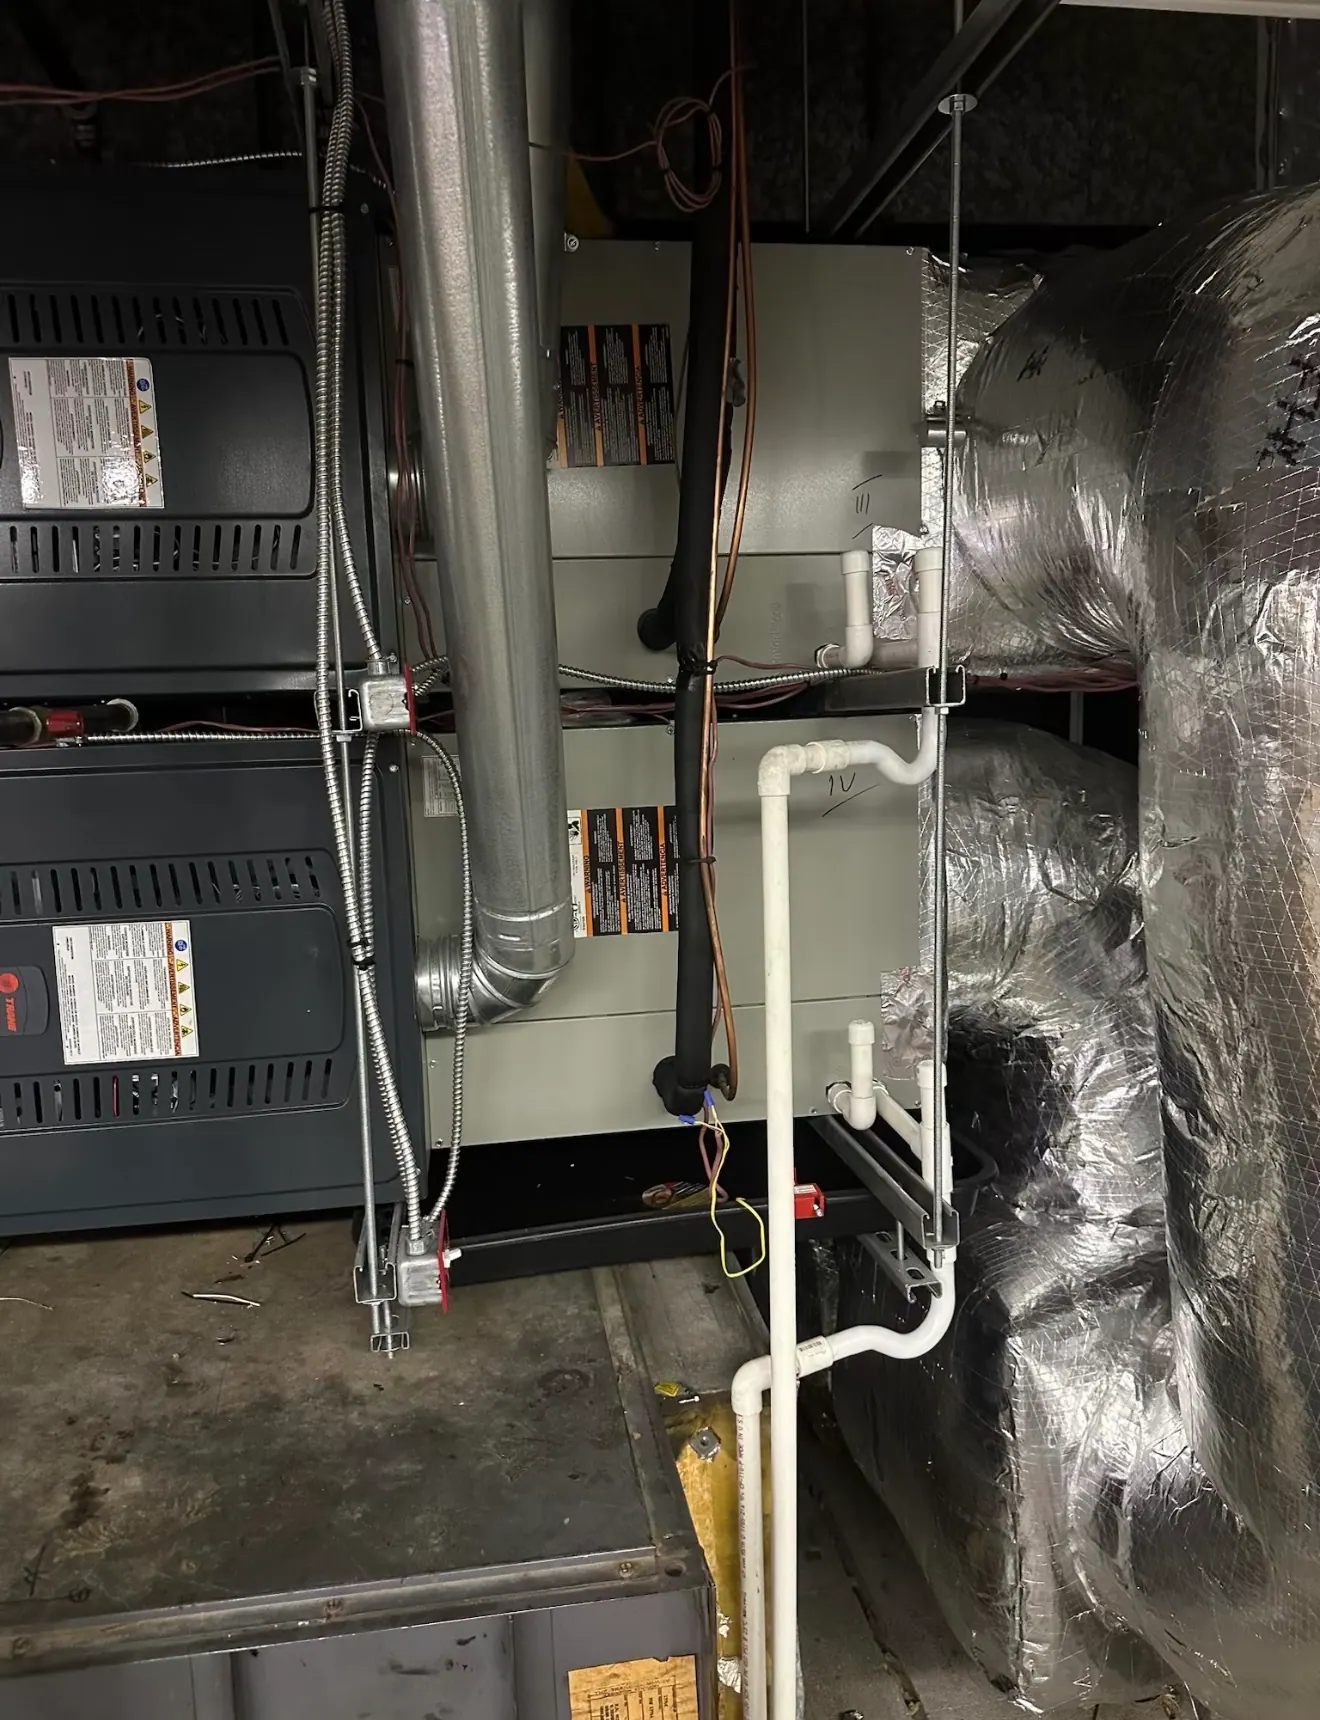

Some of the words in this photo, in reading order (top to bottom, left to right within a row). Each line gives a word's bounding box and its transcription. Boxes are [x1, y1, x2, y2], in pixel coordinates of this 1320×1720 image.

[583, 855, 592, 889] WARNING
[617, 840, 628, 897] AVERTISSEMENT
[659, 844, 669, 890] ADVERTENCIA
[165, 926, 175, 957] WARNING
[168, 963, 179, 1008] AVERTISSEMENT
[5, 998, 17, 1033] TRANE
[172, 1016, 182, 1057] ADVERTENCIA
